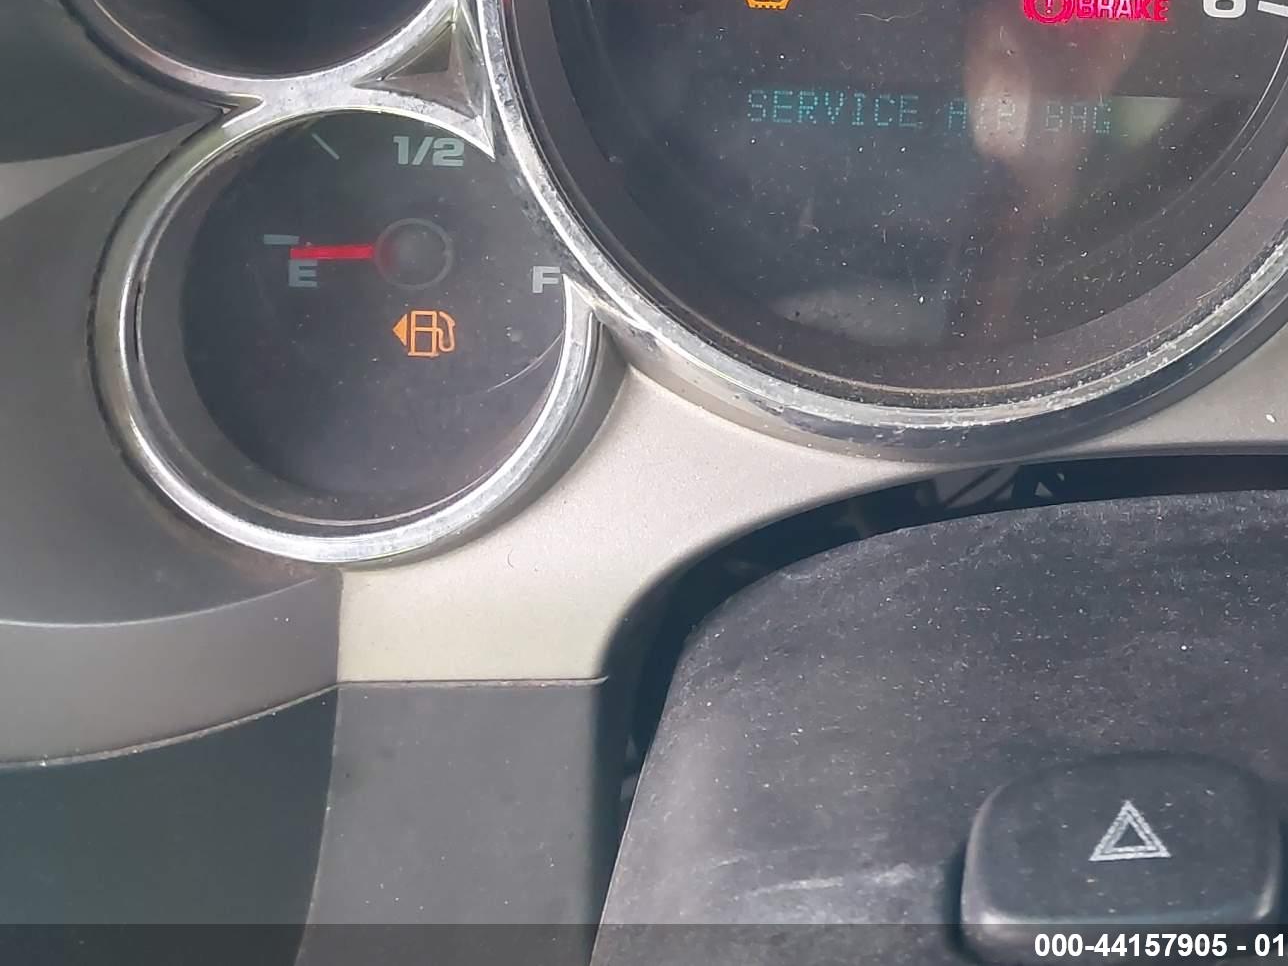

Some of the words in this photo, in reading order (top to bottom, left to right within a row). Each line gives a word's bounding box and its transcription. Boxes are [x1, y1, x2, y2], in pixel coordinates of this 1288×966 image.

[747, 89, 923, 129] SERVICE
[393, 135, 465, 168] 1/2
[288, 259, 318, 288] E
[532, 265, 562, 294] F
